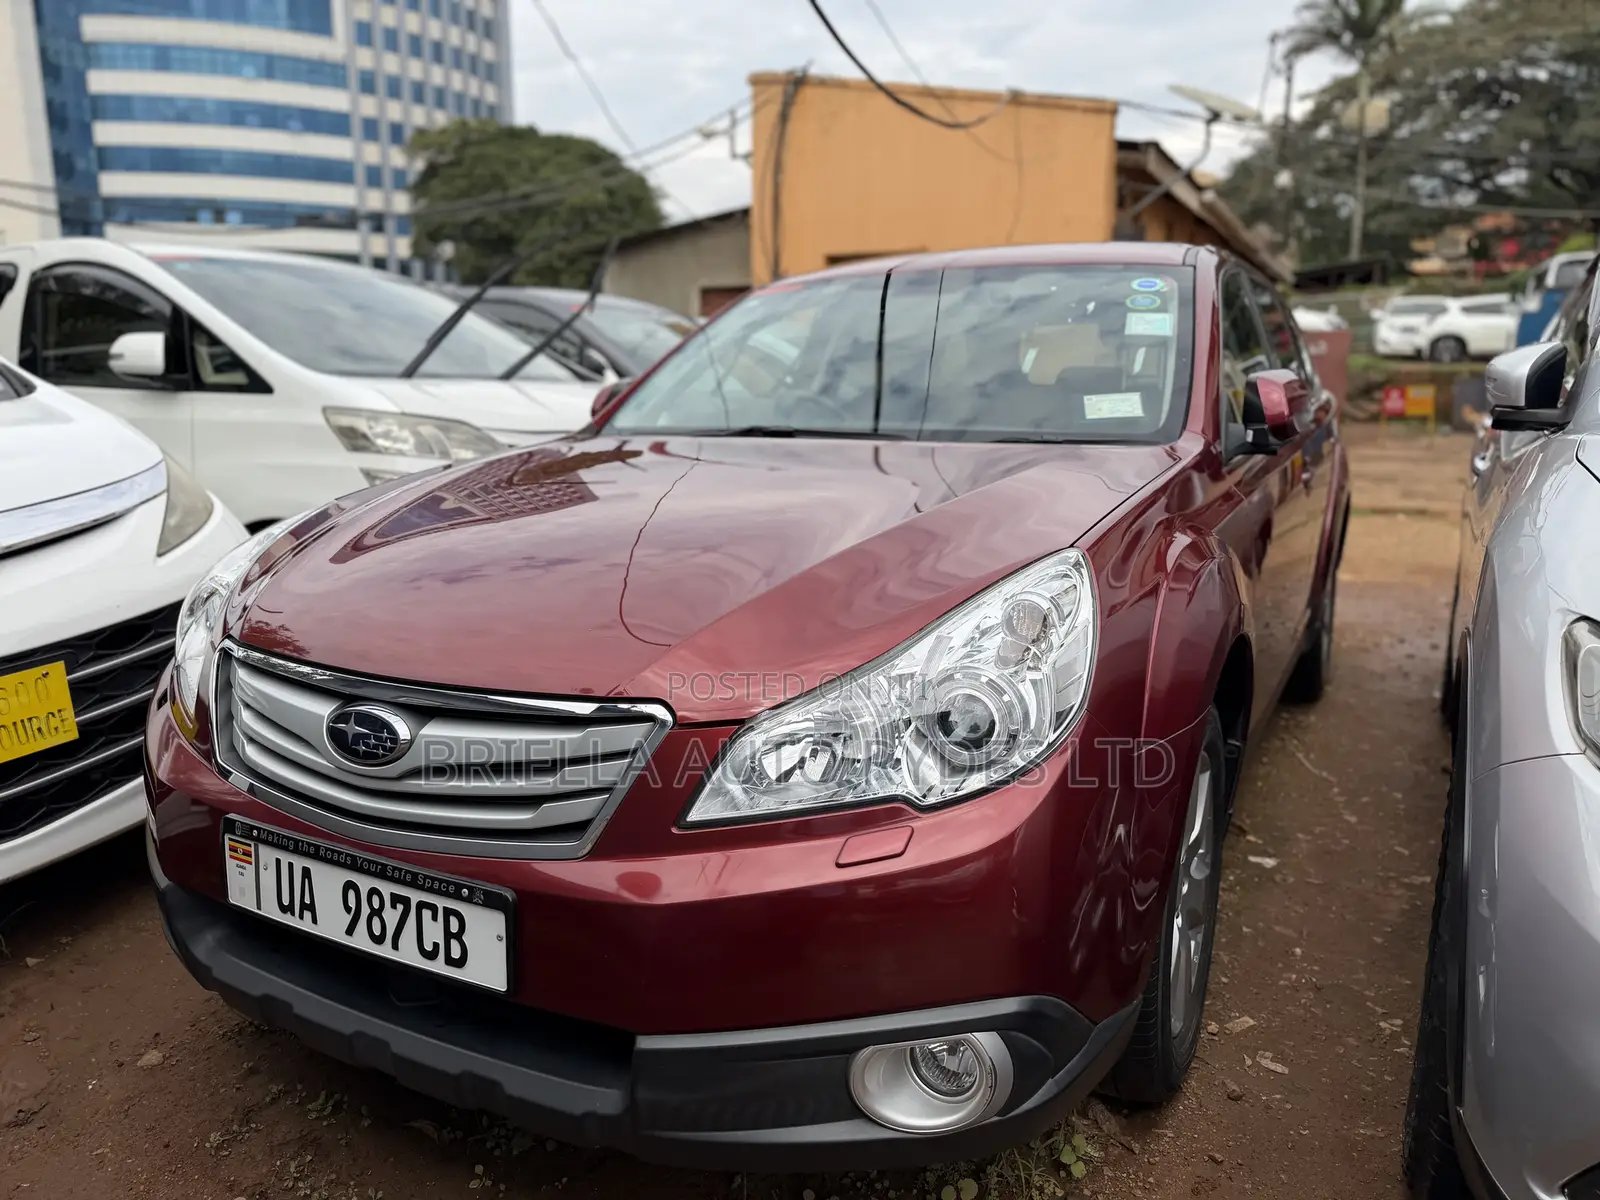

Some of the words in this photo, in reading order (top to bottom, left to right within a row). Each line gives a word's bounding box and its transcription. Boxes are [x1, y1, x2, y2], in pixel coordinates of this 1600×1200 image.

[260, 829, 294, 850] Making
[298, 841, 315, 854] the
[319, 847, 352, 865] Roads
[356, 856, 382, 873] Your
[386, 865, 412, 882] Safe
[417, 874, 456, 893] Space
[275, 857, 318, 925] UA
[341, 879, 468, 969] 987CB
